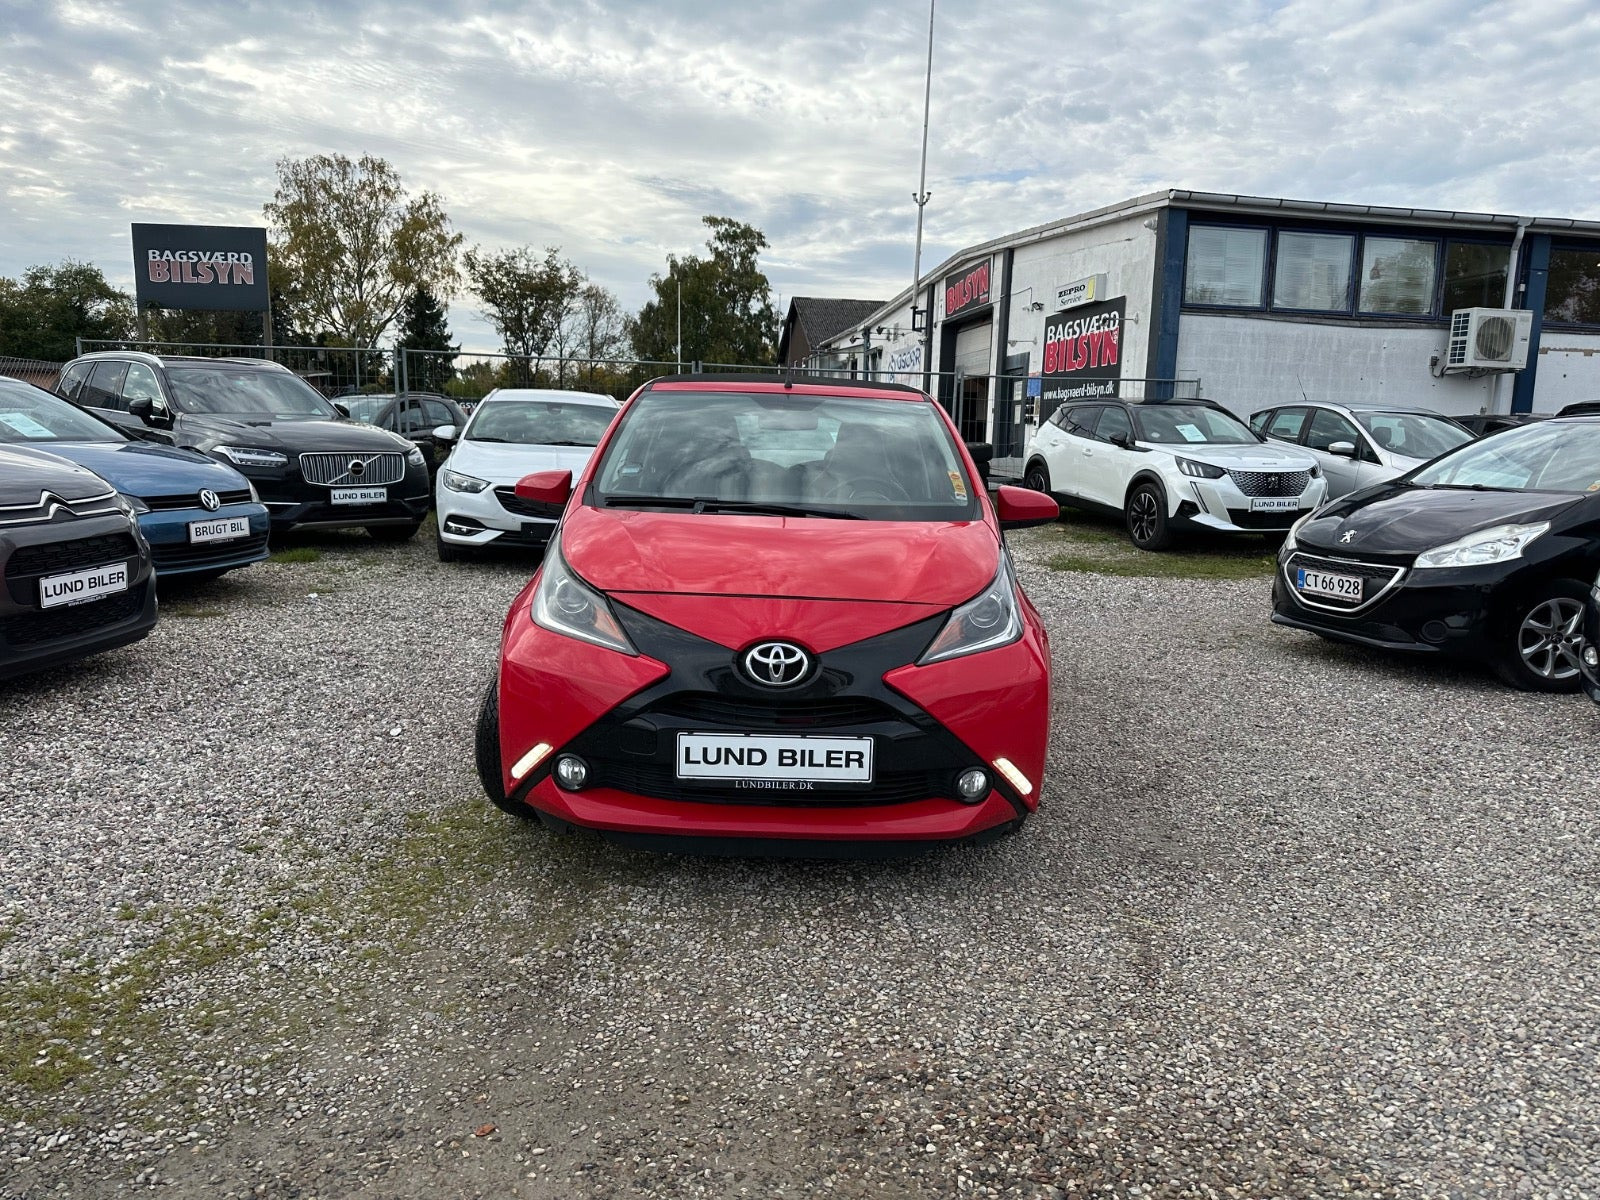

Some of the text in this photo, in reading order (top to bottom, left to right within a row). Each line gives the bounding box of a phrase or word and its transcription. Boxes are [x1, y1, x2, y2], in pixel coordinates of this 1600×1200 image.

[148, 249, 253, 264] BAGSVÆRD
[148, 260, 255, 285] BILSYN
[946, 261, 989, 315] BILSYN
[1058, 284, 1086, 298] ZEPRO
[1060, 295, 1082, 307] Service
[1044, 326, 1120, 374] BILSYN
[1043, 380, 1115, 401] www.bagsvaerd-bilsyn.dk
[333, 491, 386, 500] LUND BILER
[195, 521, 245, 537] BRUGT BIL
[44, 570, 125, 599] LUND BILER
[1305, 573, 1319, 588] CT
[1321, 575, 1335, 591] 66
[1337, 578, 1360, 596] 928
[684, 746, 865, 769] LUND BILER
[735, 780, 814, 790] LUNDBILER.DK
